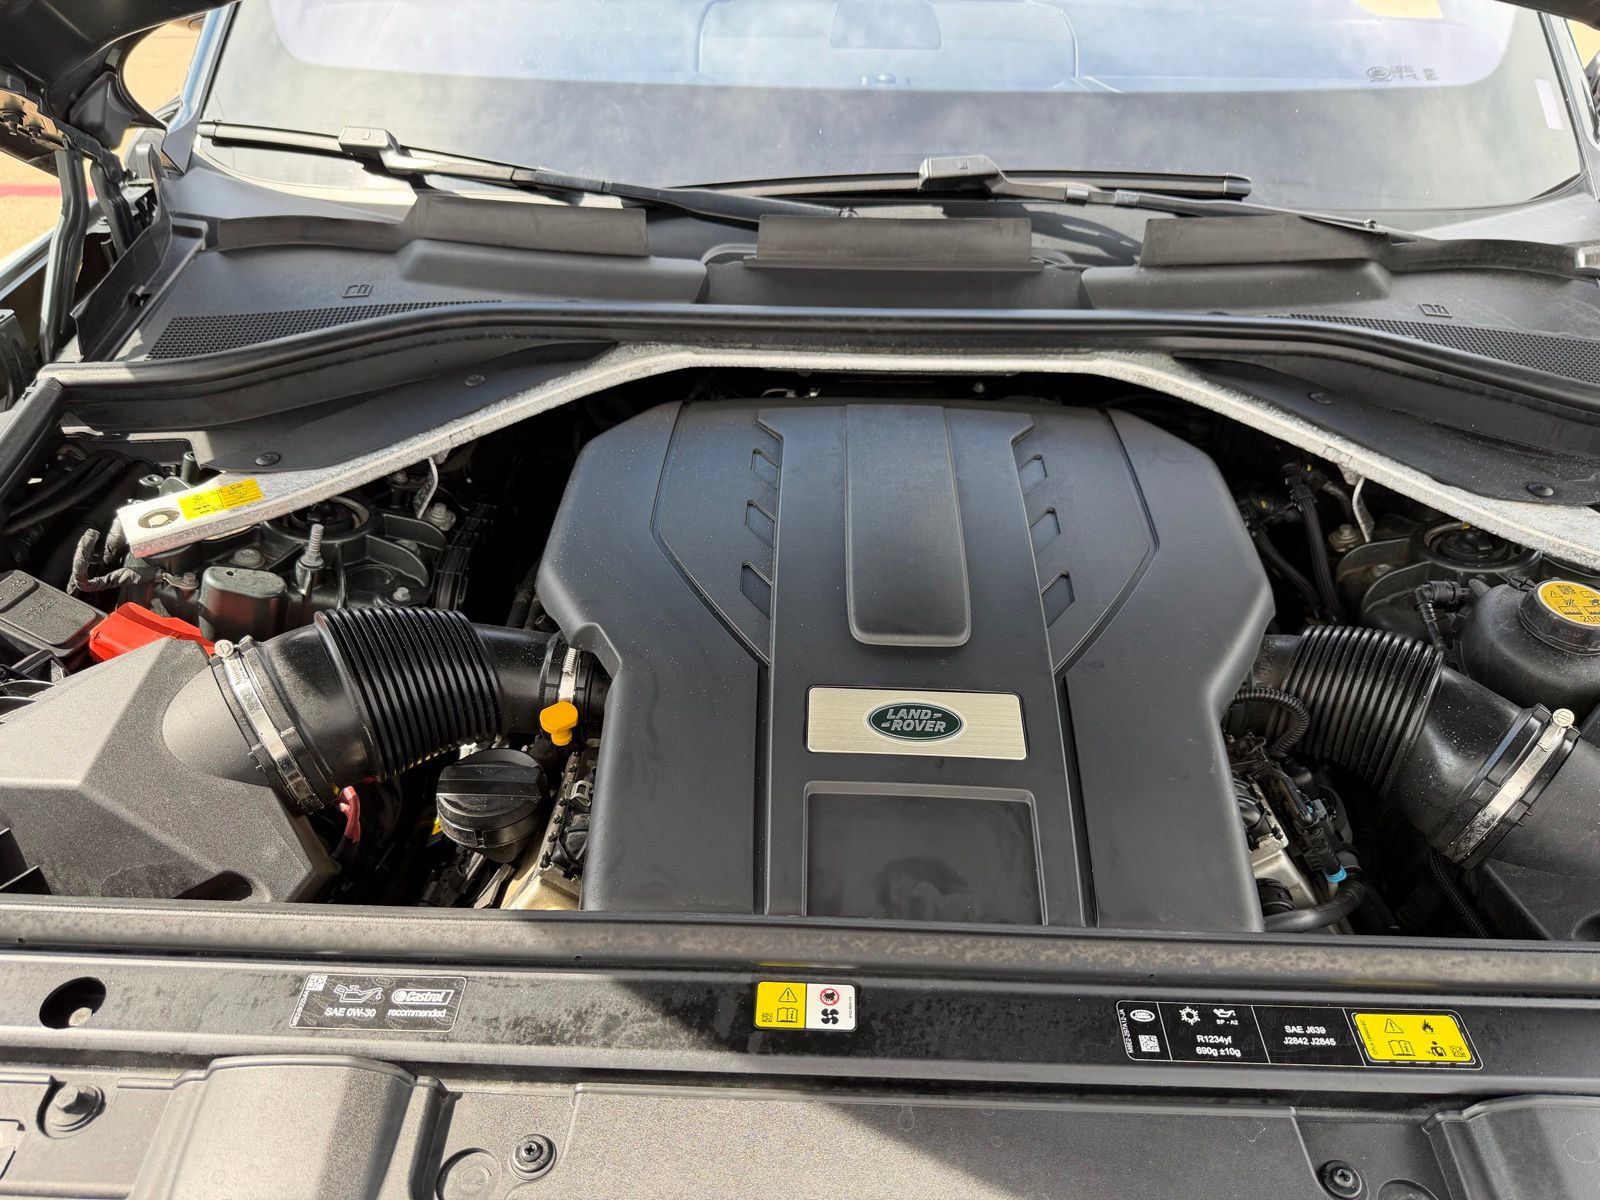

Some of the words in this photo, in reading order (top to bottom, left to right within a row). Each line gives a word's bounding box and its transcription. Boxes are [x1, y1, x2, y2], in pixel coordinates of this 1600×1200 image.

[405, 991, 446, 1003] Castrol
[324, 1007, 346, 1017] SAE
[346, 1007, 377, 1018] 0W-30
[387, 1008, 447, 1018] recommended
[1284, 1025, 1305, 1034] SAE
[1305, 1025, 1327, 1035] J639
[1196, 1034, 1232, 1046] R1234yf
[1283, 1036, 1310, 1045] J2842
[1310, 1037, 1337, 1046] J2845
